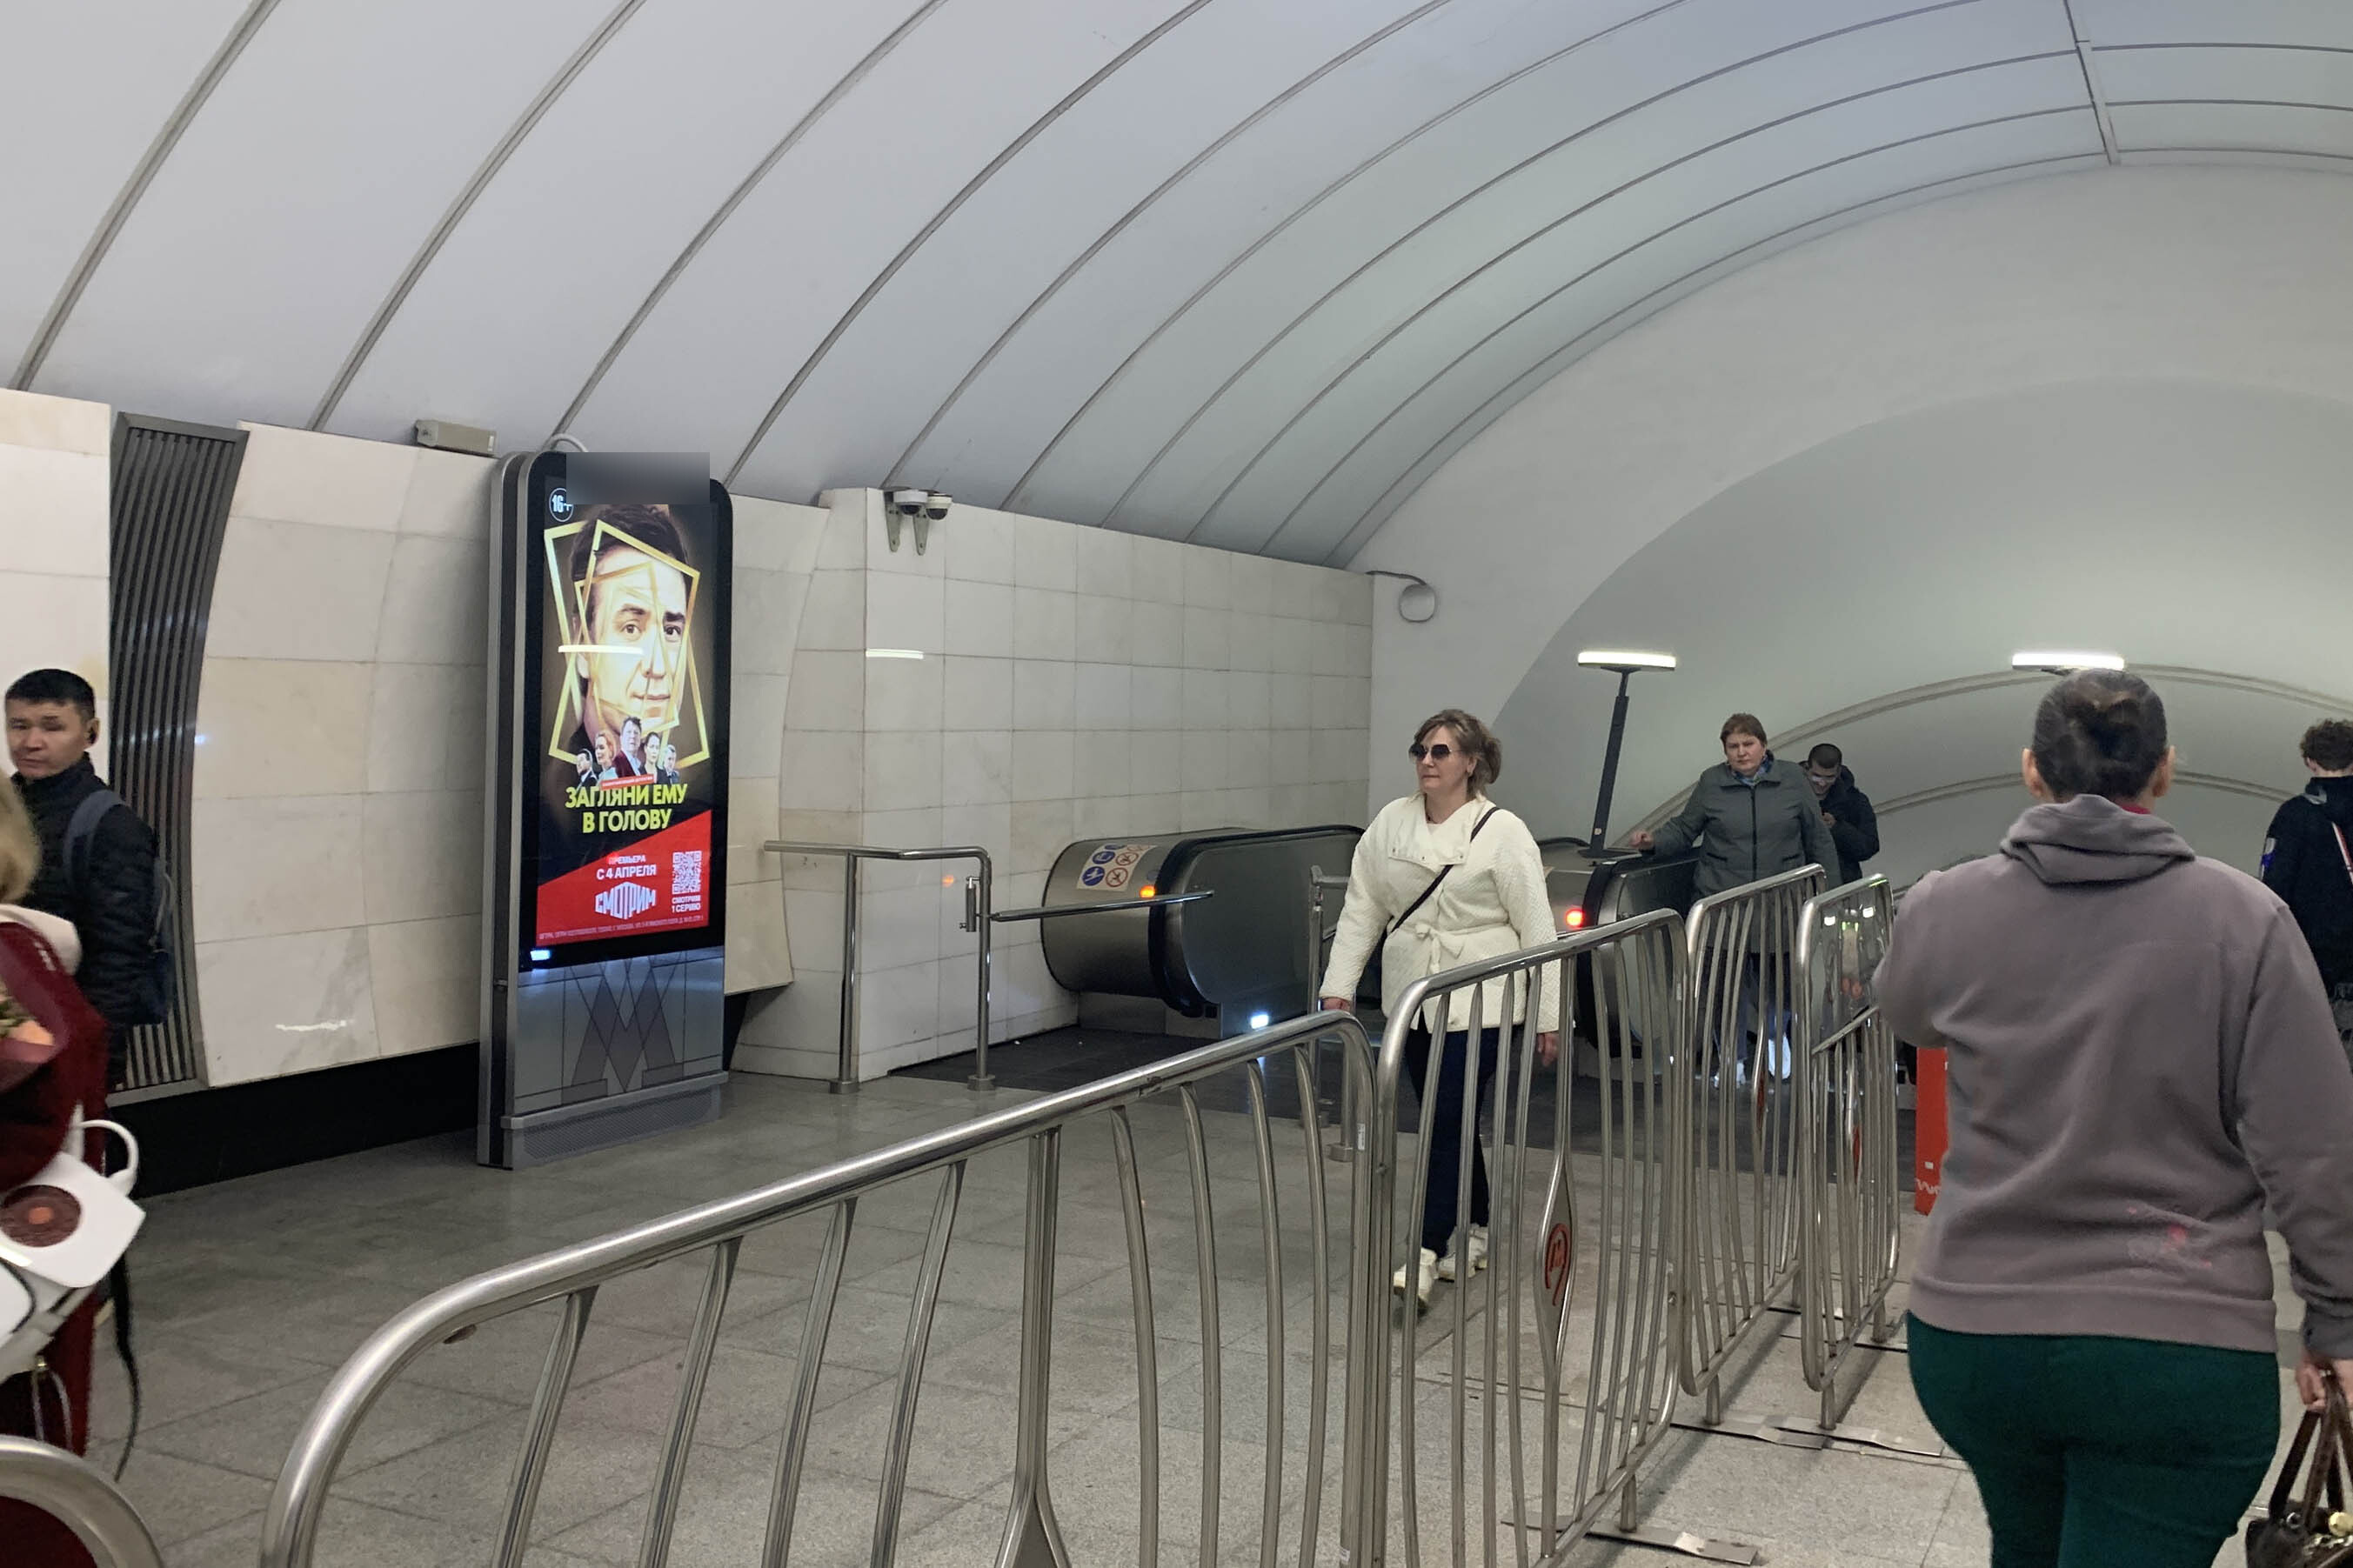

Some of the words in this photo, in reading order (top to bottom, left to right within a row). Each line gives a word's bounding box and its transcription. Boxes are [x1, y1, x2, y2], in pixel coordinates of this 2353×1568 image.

[551, 495, 572, 512] 16+
[565, 784, 649, 808] ЗАГЛЯНИ
[654, 784, 688, 804] ЕМУ
[583, 812, 595, 833] В
[598, 808, 672, 833] ГОЛОВУ
[608, 854, 646, 865] ПРЕМЬЕРА
[596, 868, 605, 880] С
[605, 867, 614, 879] 4
[614, 864, 657, 878] АПРЕЛЯ
[595, 881, 657, 920] СМОТРИМ
